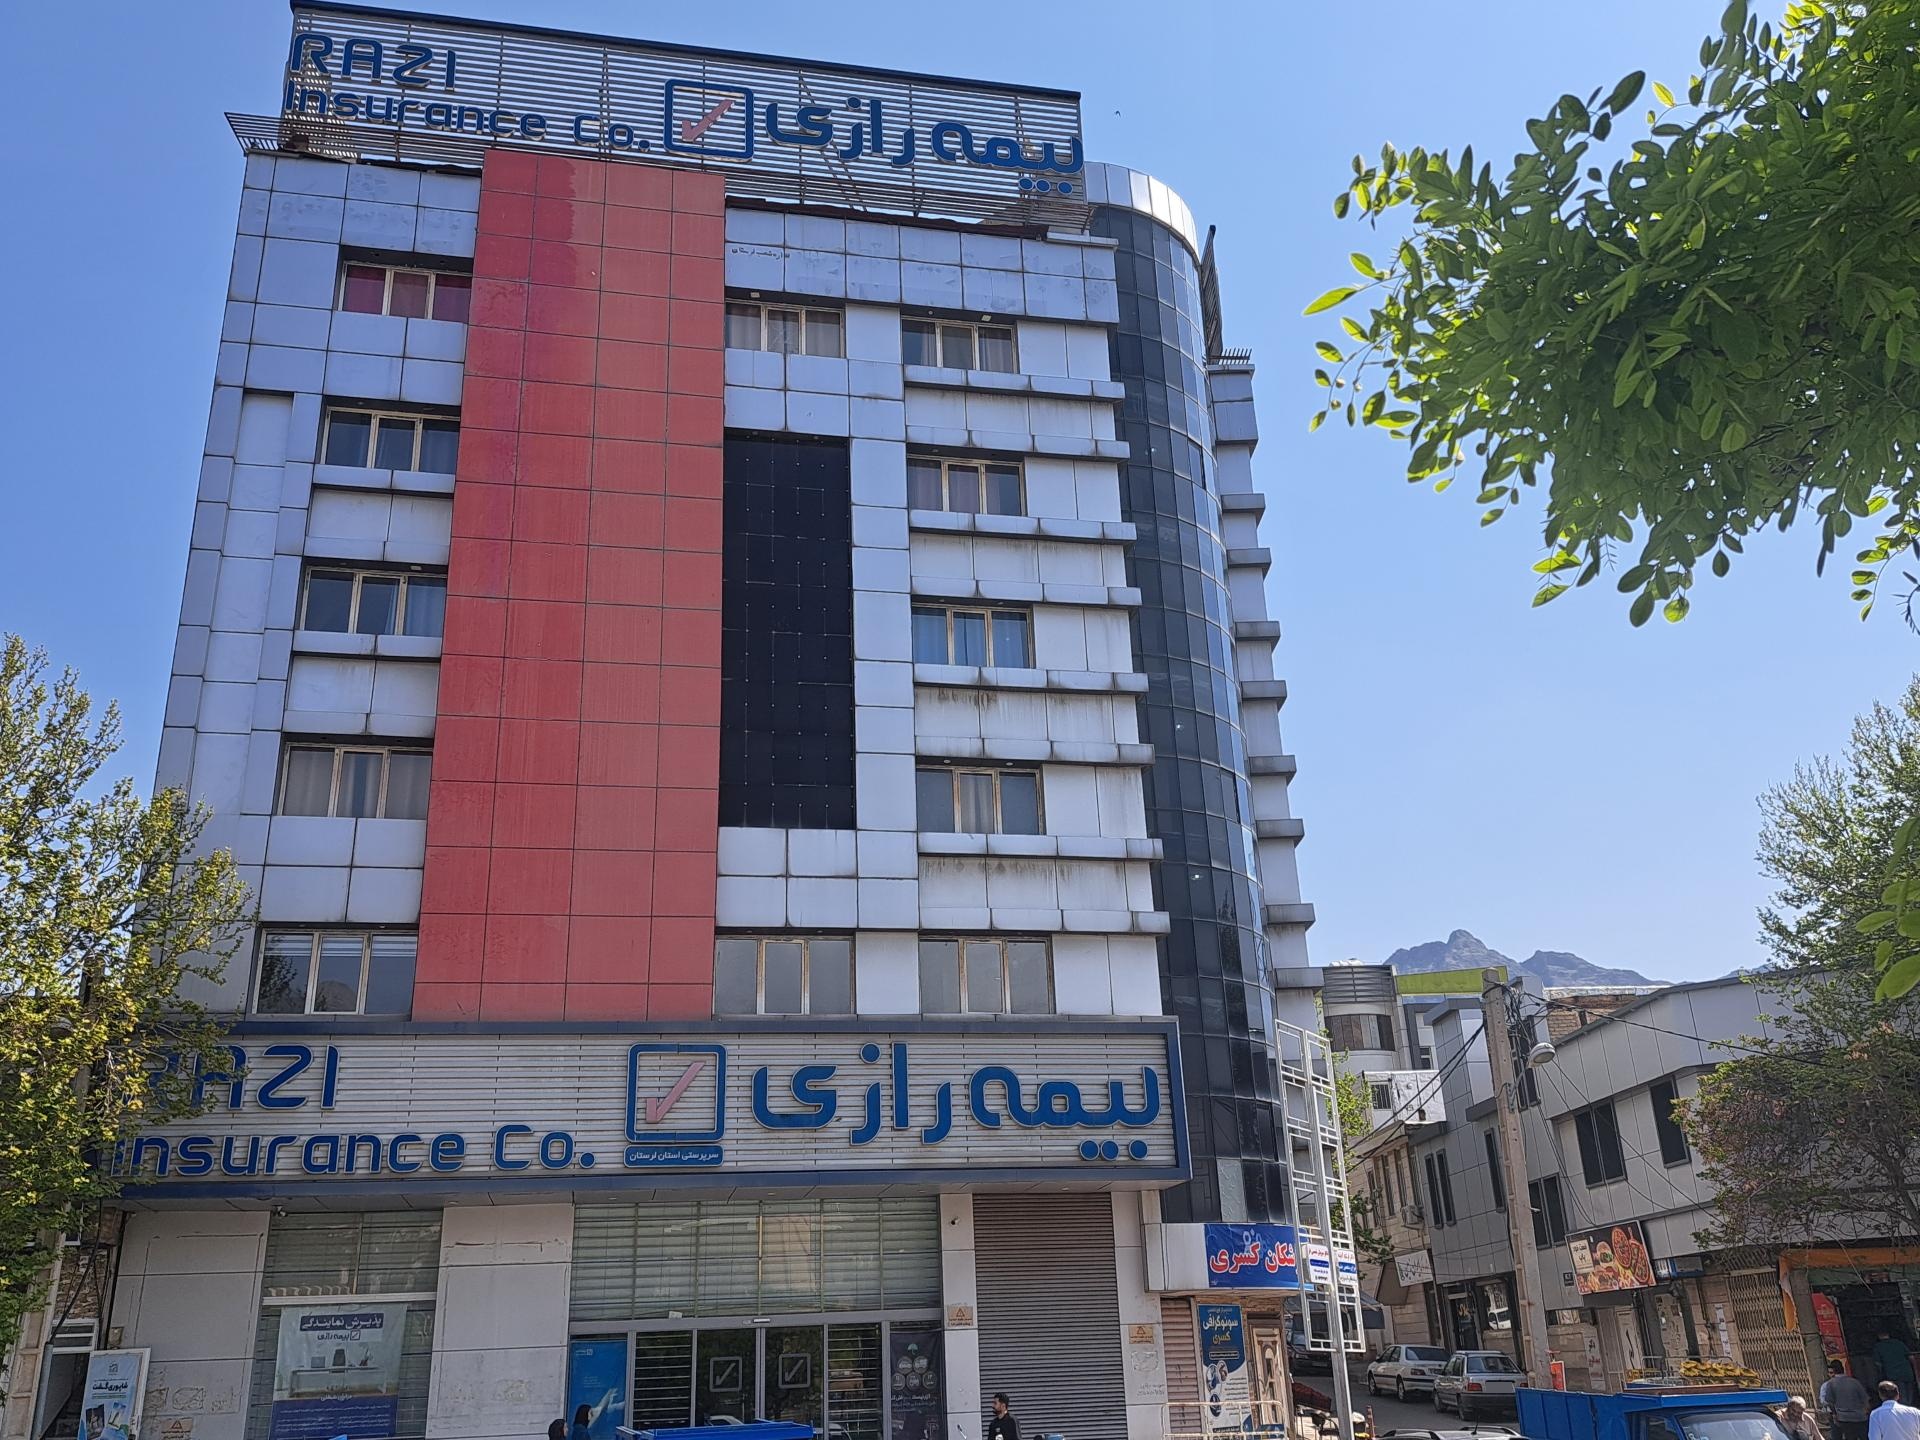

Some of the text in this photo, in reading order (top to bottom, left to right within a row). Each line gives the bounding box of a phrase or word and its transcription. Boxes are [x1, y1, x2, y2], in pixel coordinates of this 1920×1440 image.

[290, 33, 456, 92] RAZI
[285, 79, 651, 152] Insurance Co.
[765, 96, 1084, 195] بیمه رازی
[752, 1042, 1161, 1162] بیمه رازی
[111, 1124, 596, 1177] Insurance Co.
[629, 1151, 719, 1162] سرپرستی استان لرستان
[1209, 1241, 1261, 1274] کسری
[317, 1332, 350, 1342] بیمه رازی
[345, 1314, 383, 1330] پذیرش
[1202, 1313, 1239, 1331] سونوگرافی
[1212, 1331, 1232, 1345] کسری
